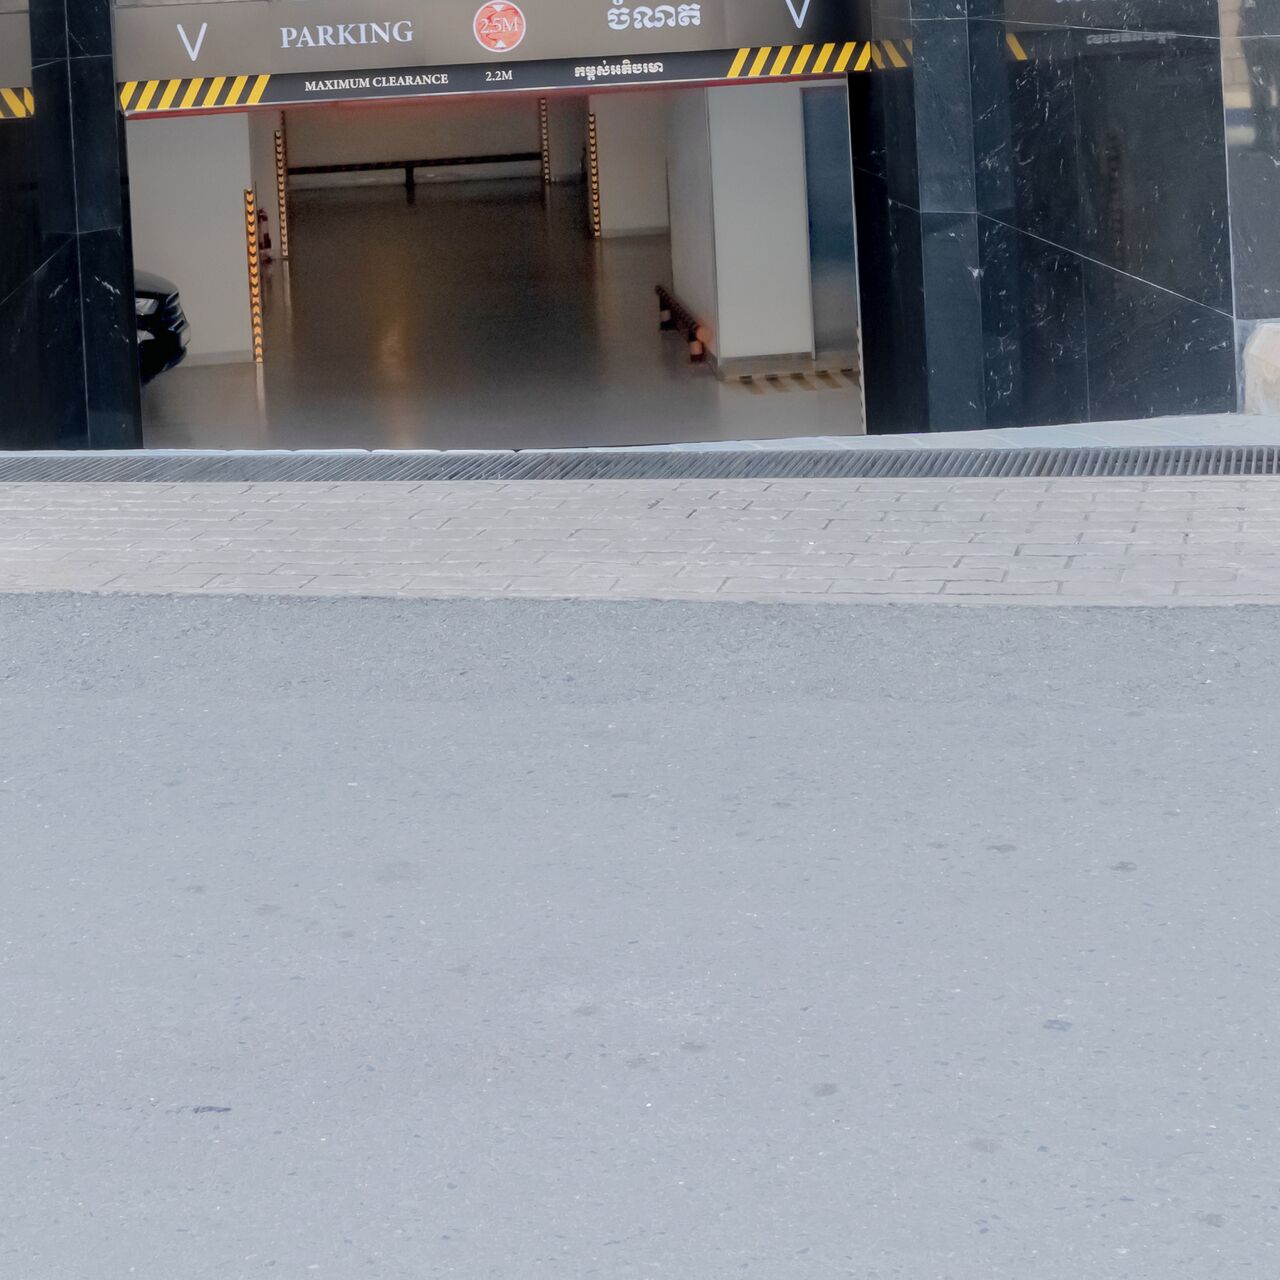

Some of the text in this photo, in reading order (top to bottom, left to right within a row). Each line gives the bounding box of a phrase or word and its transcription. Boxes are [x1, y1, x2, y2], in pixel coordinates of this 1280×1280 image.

[280, 20, 414, 49] PARKING
[304, 70, 513, 92] MAXIMUM CLEARANCE 2.2M
